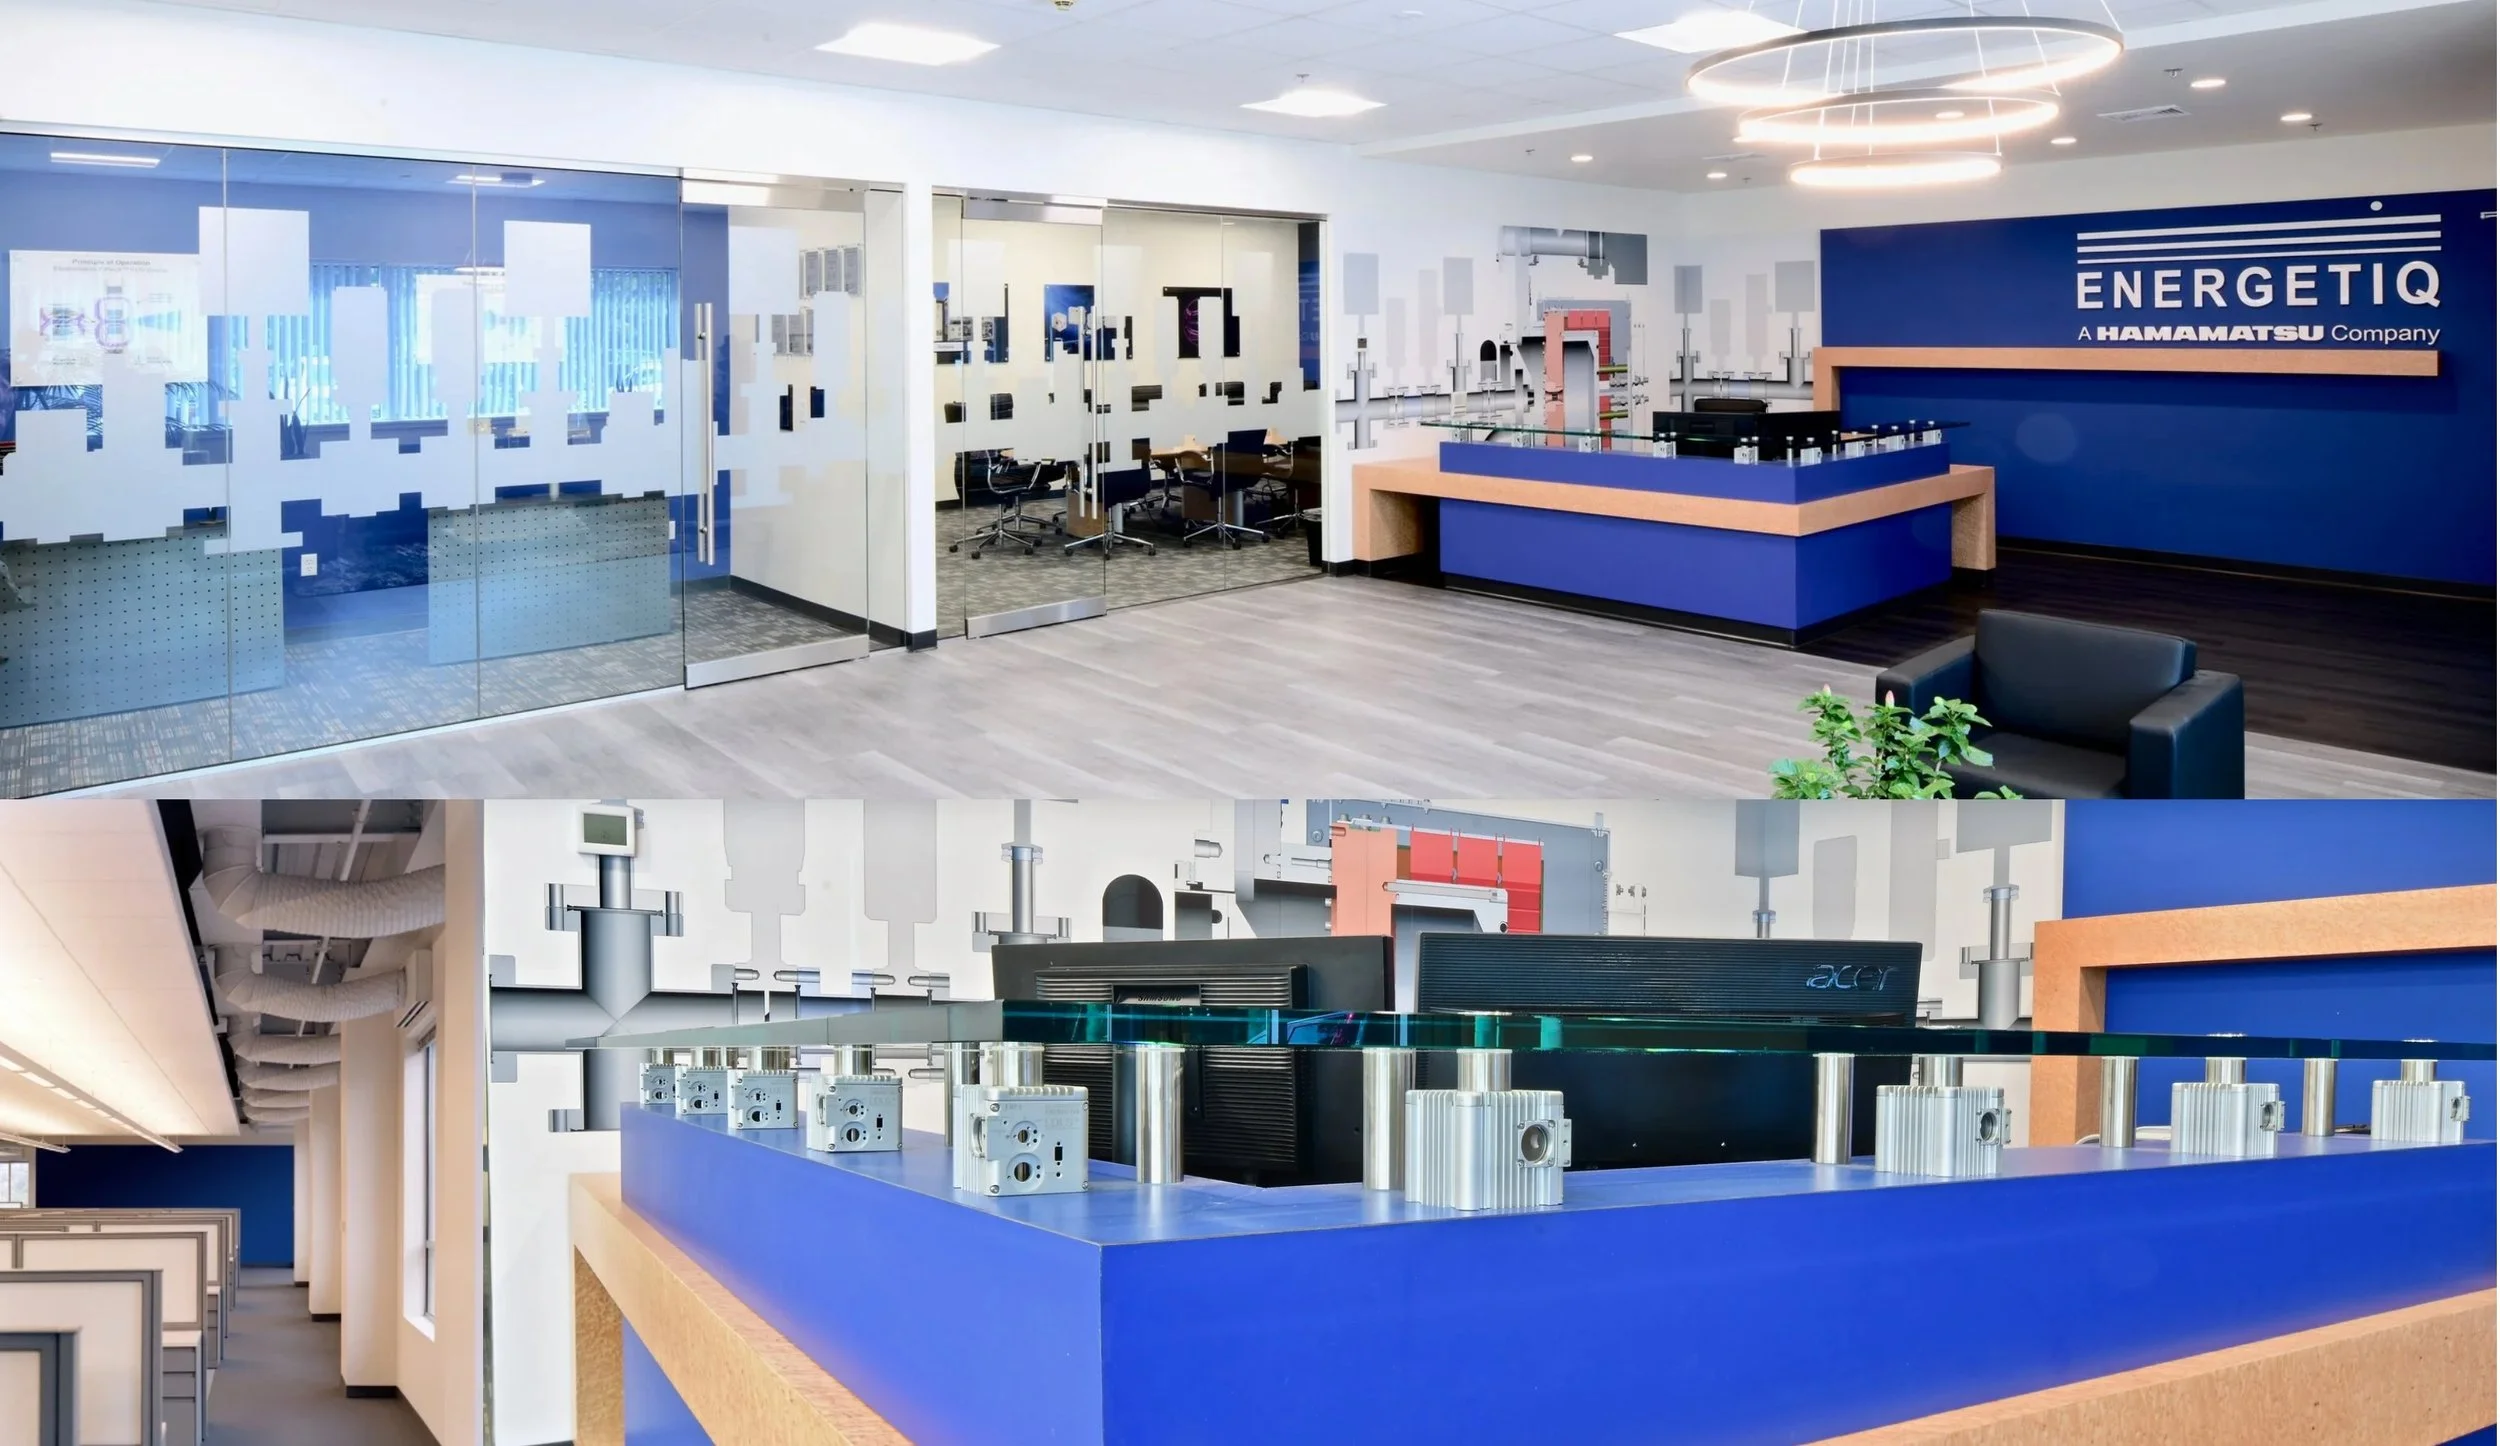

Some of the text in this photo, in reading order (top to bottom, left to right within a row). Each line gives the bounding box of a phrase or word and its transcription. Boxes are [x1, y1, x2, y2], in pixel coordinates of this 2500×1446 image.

[2077, 260, 2441, 309] ENERGETIQ
[2078, 325, 2441, 345] A HAMAMATSU Company
[1806, 964, 1897, 991] acer
